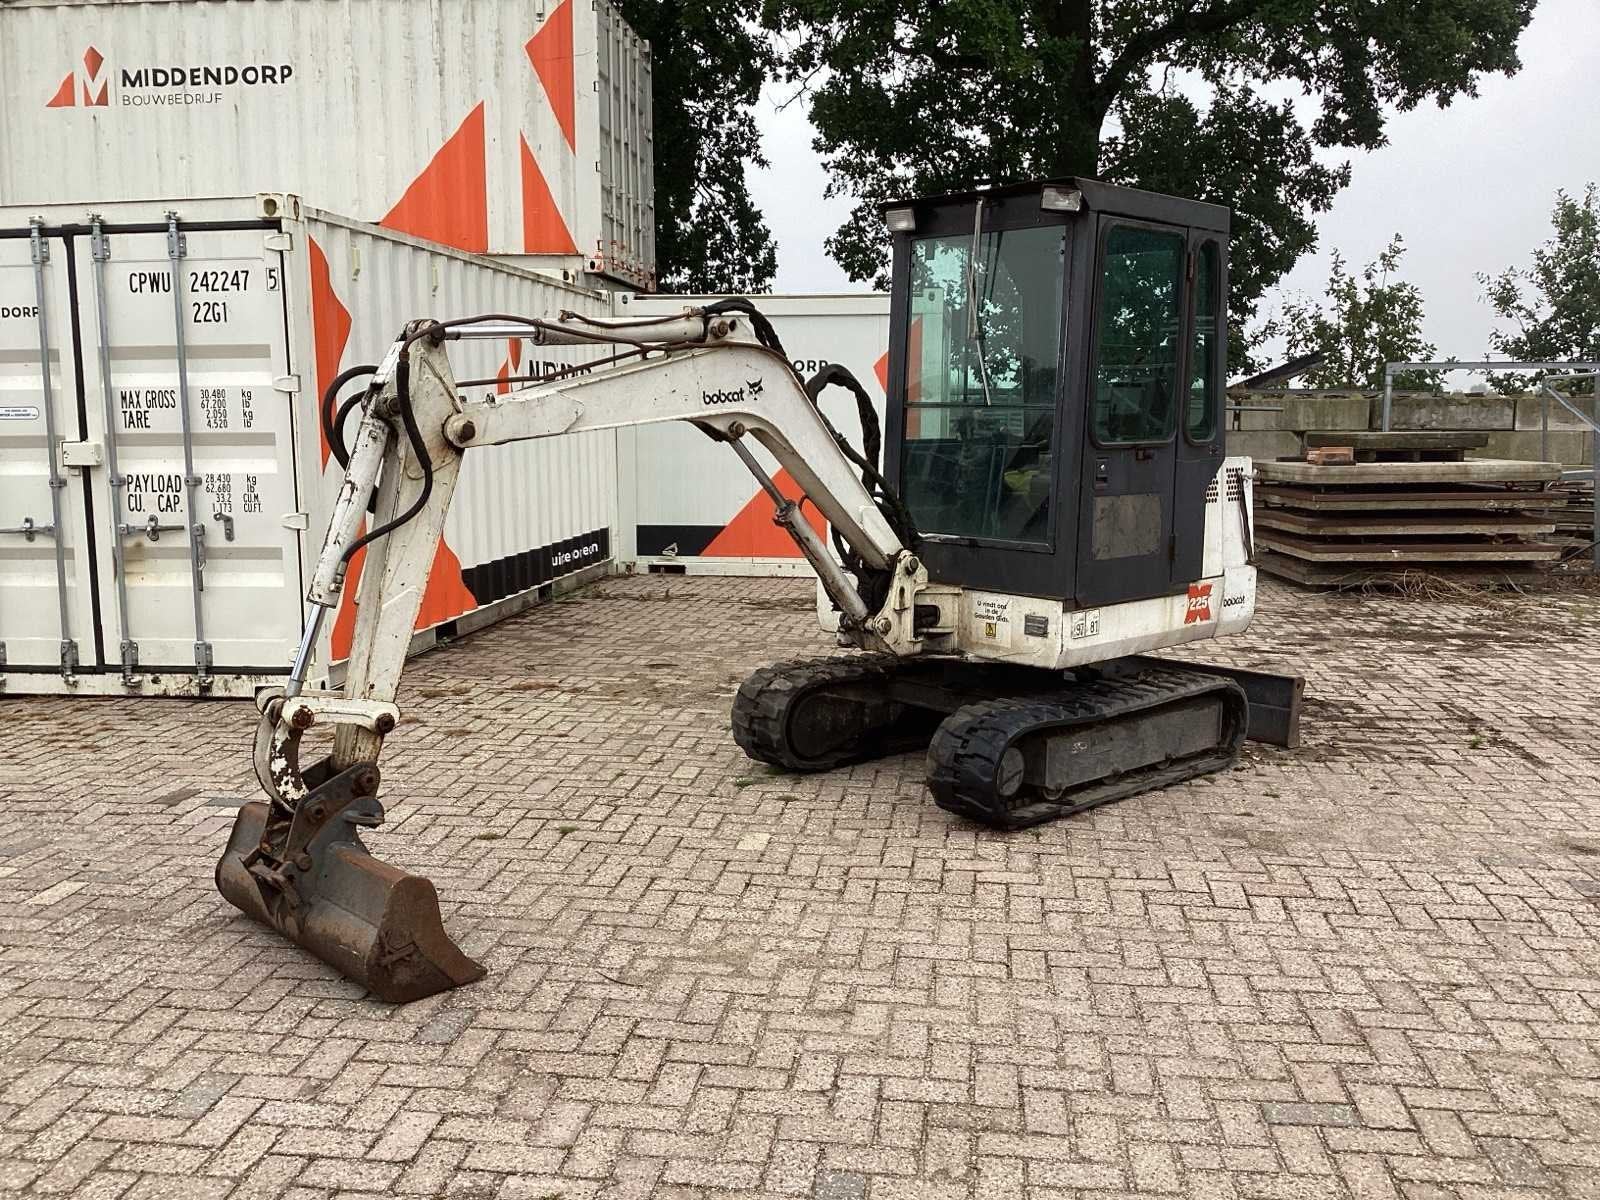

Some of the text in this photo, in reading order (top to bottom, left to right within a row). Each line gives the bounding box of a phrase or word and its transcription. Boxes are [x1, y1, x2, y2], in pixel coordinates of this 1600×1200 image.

[121, 65, 293, 88] MIDDENDORP
[122, 93, 223, 106] BOUWBEDRIJF
[129, 269, 277, 293] CPWU 242247 5
[193, 302, 228, 323] 22G1
[121, 389, 176, 409] MAX GROSS
[200, 388, 252, 401] 30.480 kg
[703, 388, 745, 405] bobcat
[200, 398, 250, 409] 67.200 lb
[122, 410, 151, 429] TARE
[242, 408, 254, 421] kg
[243, 418, 252, 429] lb
[126, 475, 182, 493] PAYLOAD
[246, 473, 257, 486] kg
[128, 495, 183, 513] CU. CAP.
[1189, 596, 1208, 611] 225
